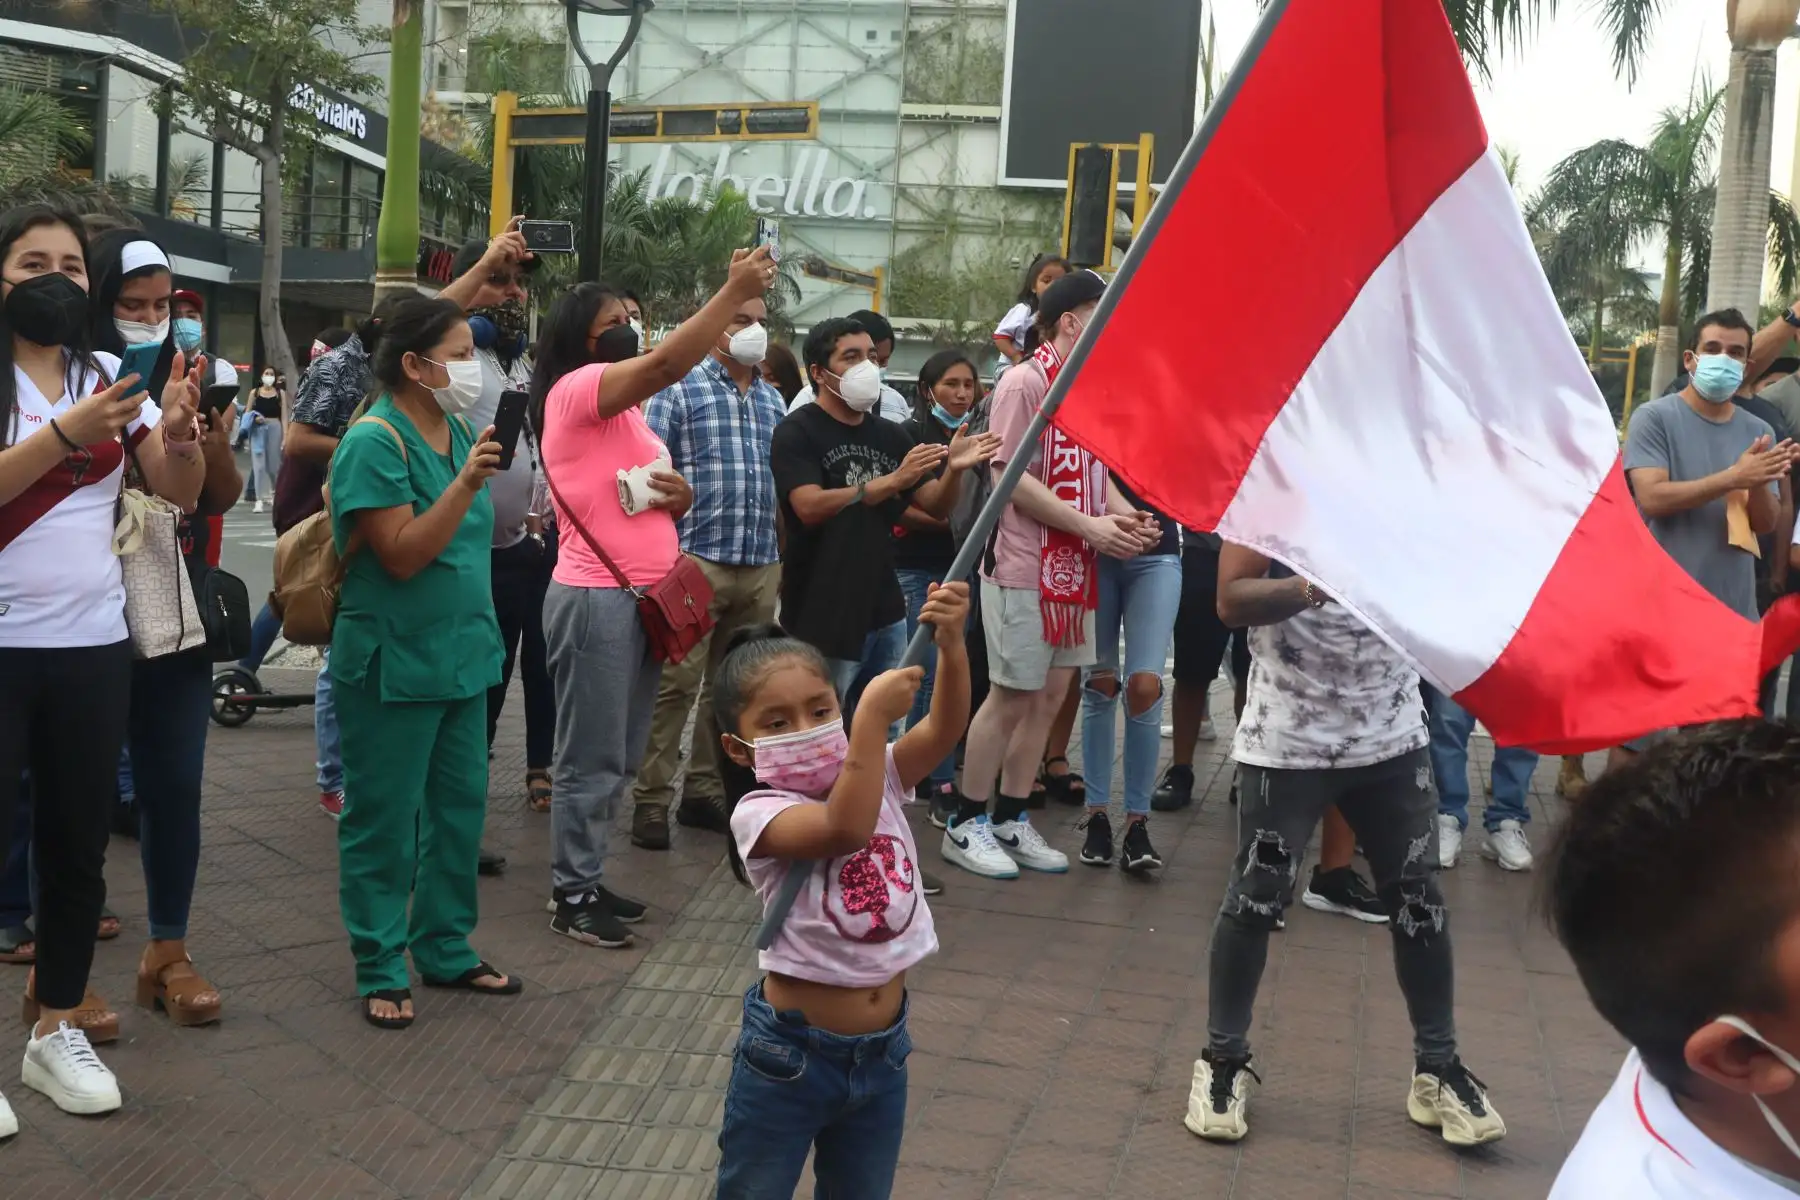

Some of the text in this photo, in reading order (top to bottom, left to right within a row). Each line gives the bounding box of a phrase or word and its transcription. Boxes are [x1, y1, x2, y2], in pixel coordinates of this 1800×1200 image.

[287, 82, 366, 139] cDonald's
[645, 143, 876, 218] labella.
[1052, 427, 1082, 512] RU
